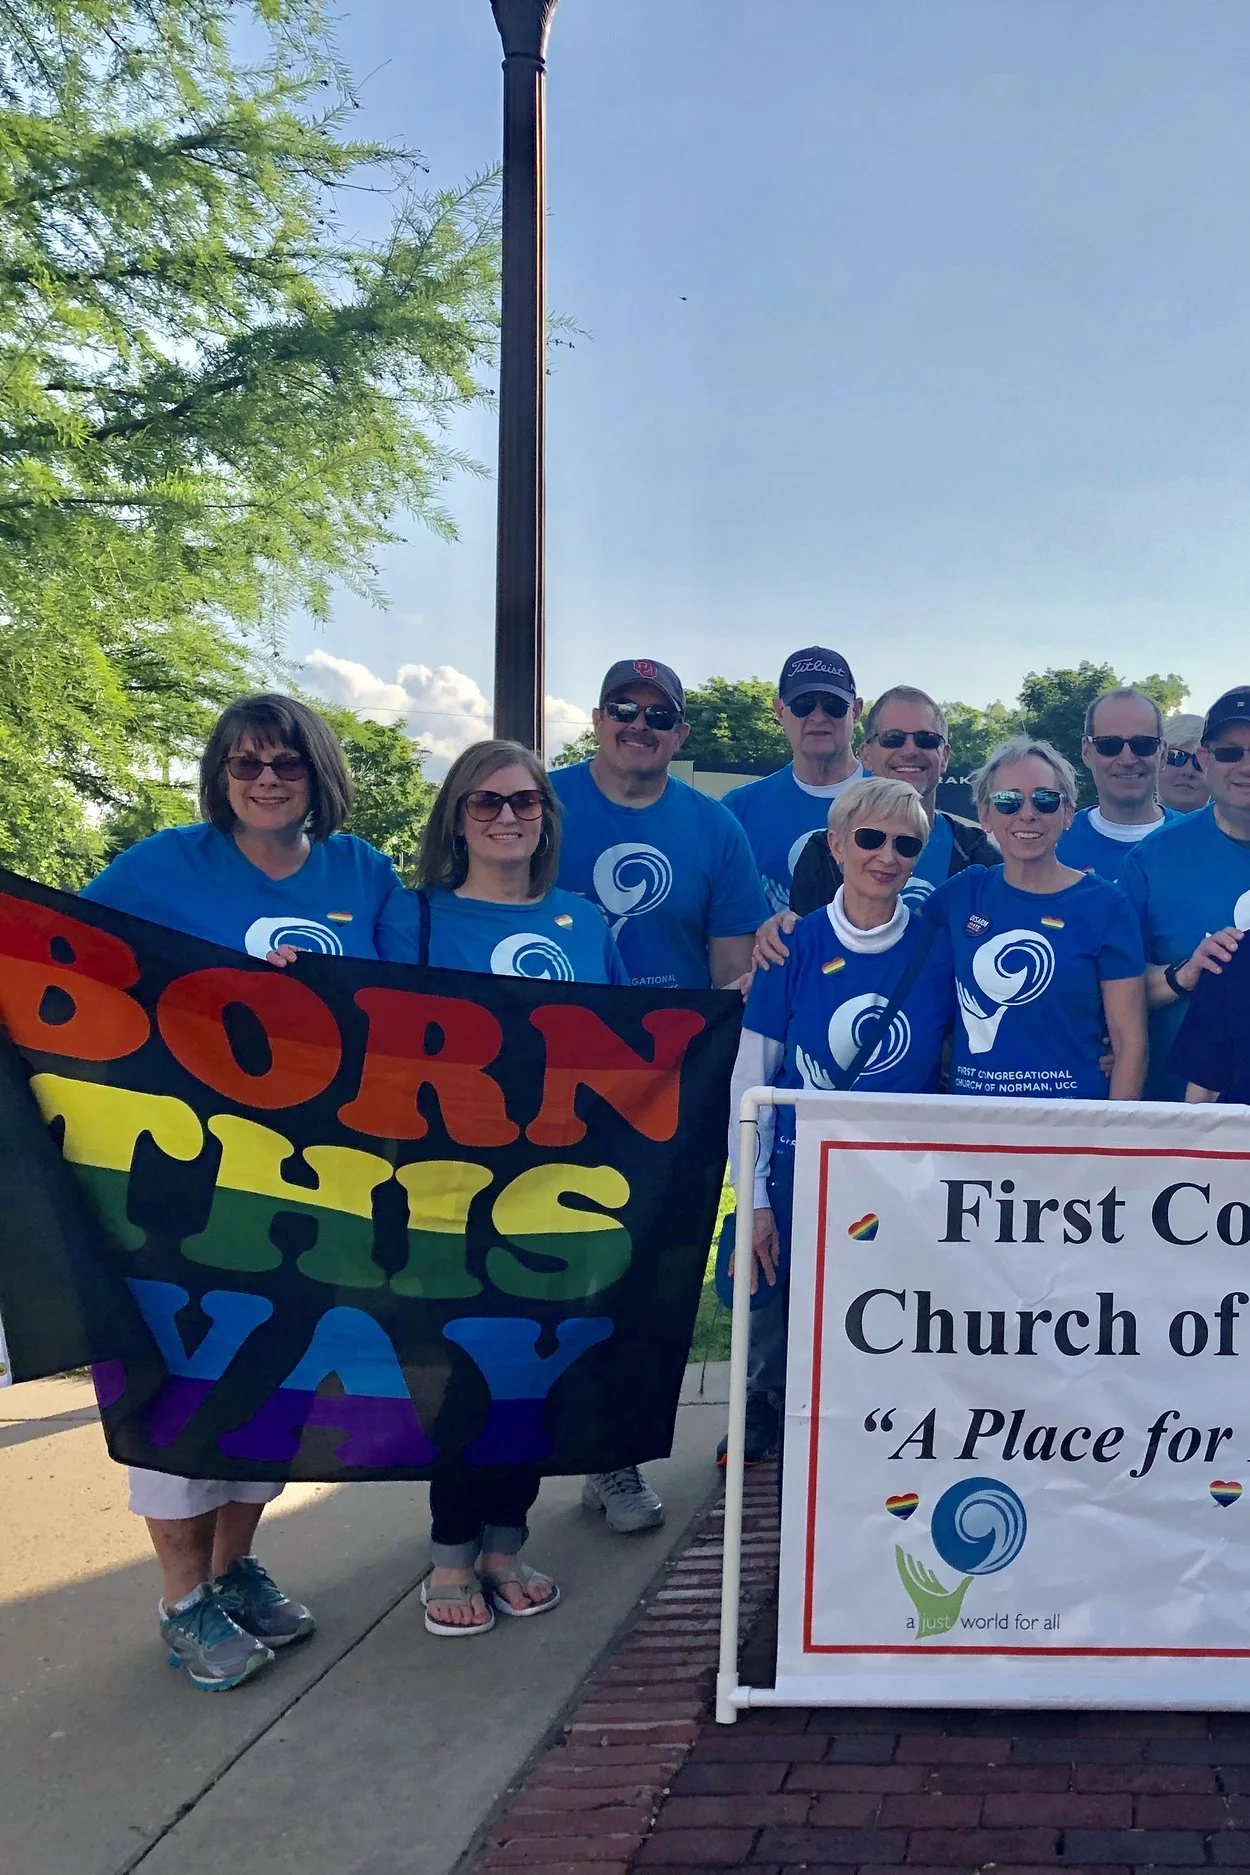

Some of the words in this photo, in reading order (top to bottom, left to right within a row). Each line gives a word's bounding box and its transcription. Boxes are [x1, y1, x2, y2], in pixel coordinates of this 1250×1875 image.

[787, 658, 846, 677] Titleist
[0, 891, 705, 1147] BORN
[955, 1078, 982, 1091] CHURCH
[984, 1083, 996, 1092] OF
[999, 1081, 1052, 1093] NORMAN,
[1055, 1081, 1078, 1090] UCC
[957, 1066, 977, 1077] FIRST
[978, 1070, 1072, 1080] CONGREGATIONAL
[29, 1073, 633, 1300] THIS
[938, 1180, 1125, 1244] First
[845, 1289, 1140, 1356] Church
[1169, 1292, 1249, 1356] of
[865, 1408, 936, 1459] “A
[954, 1409, 1124, 1462] Place
[1130, 1410, 1233, 1478] for
[906, 1617, 915, 1629] a
[921, 1613, 952, 1632] just
[960, 1613, 1009, 1630] world
[1015, 1613, 1039, 1630] for
[1043, 1613, 1060, 1630] all
